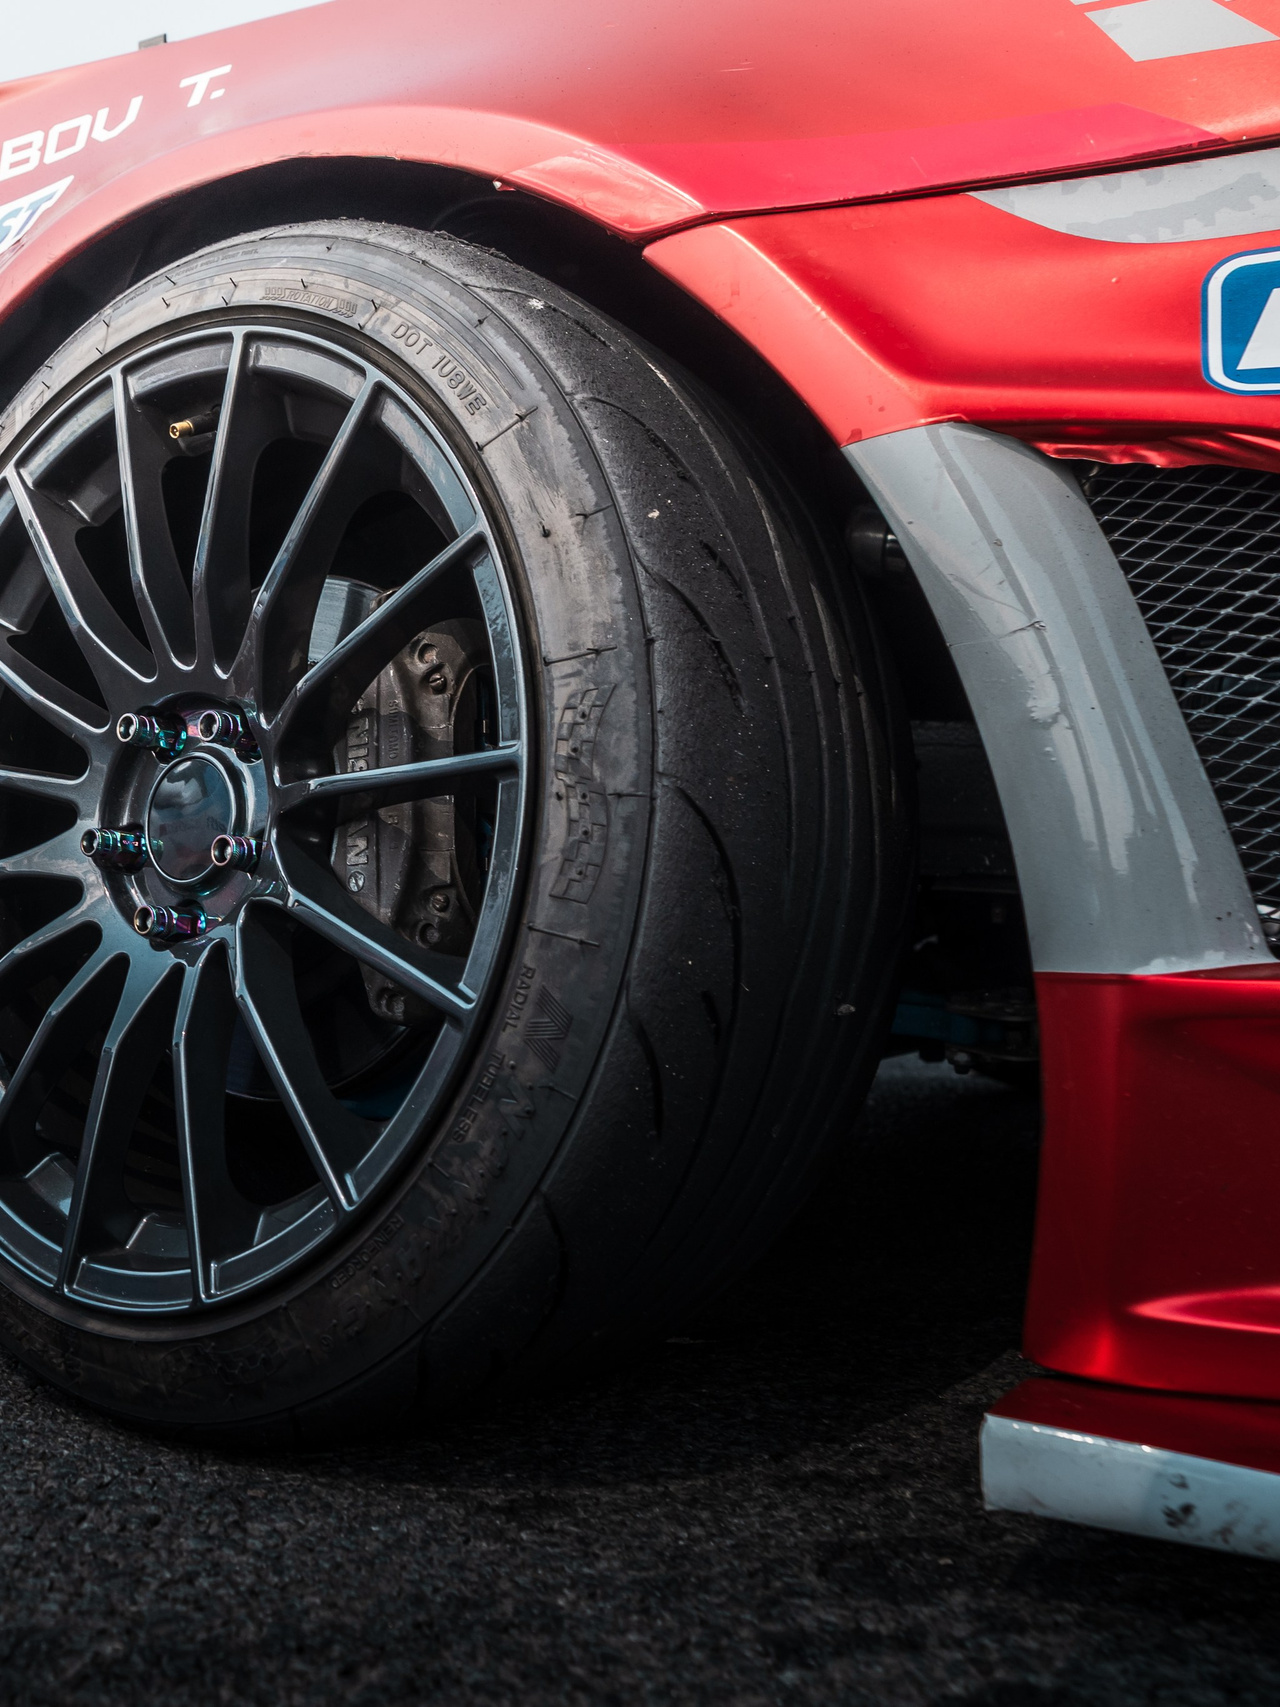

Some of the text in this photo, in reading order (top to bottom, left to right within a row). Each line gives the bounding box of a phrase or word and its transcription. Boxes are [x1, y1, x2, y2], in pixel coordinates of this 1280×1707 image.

[179, 64, 233, 108] T.
[284, 290, 335, 309] ROTATION
[391, 321, 434, 356] DOT
[501, 962, 537, 1034] RADIAL
[451, 1051, 507, 1145] TUBELESS
[329, 1212, 405, 1290] REINFORCED
